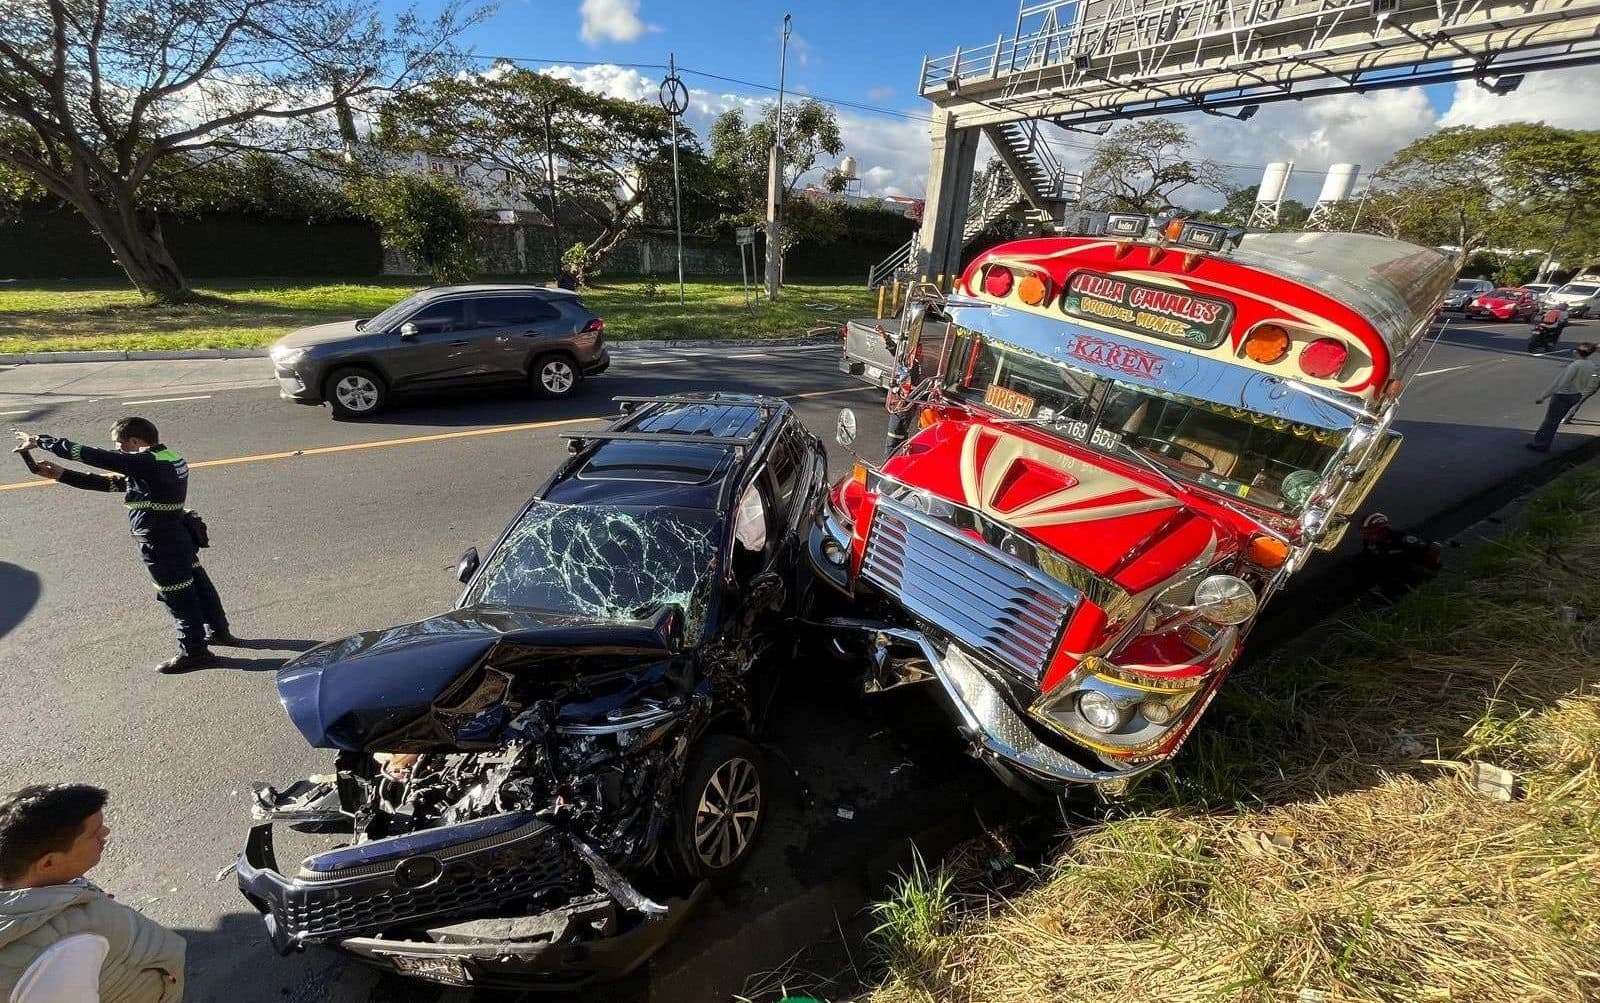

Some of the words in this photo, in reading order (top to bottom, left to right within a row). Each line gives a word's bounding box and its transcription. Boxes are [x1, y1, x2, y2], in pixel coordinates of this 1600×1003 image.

[1129, 287, 1220, 324] CANALES
[1074, 339, 1156, 374] KAREN
[985, 384, 1034, 419] DIRECTO
